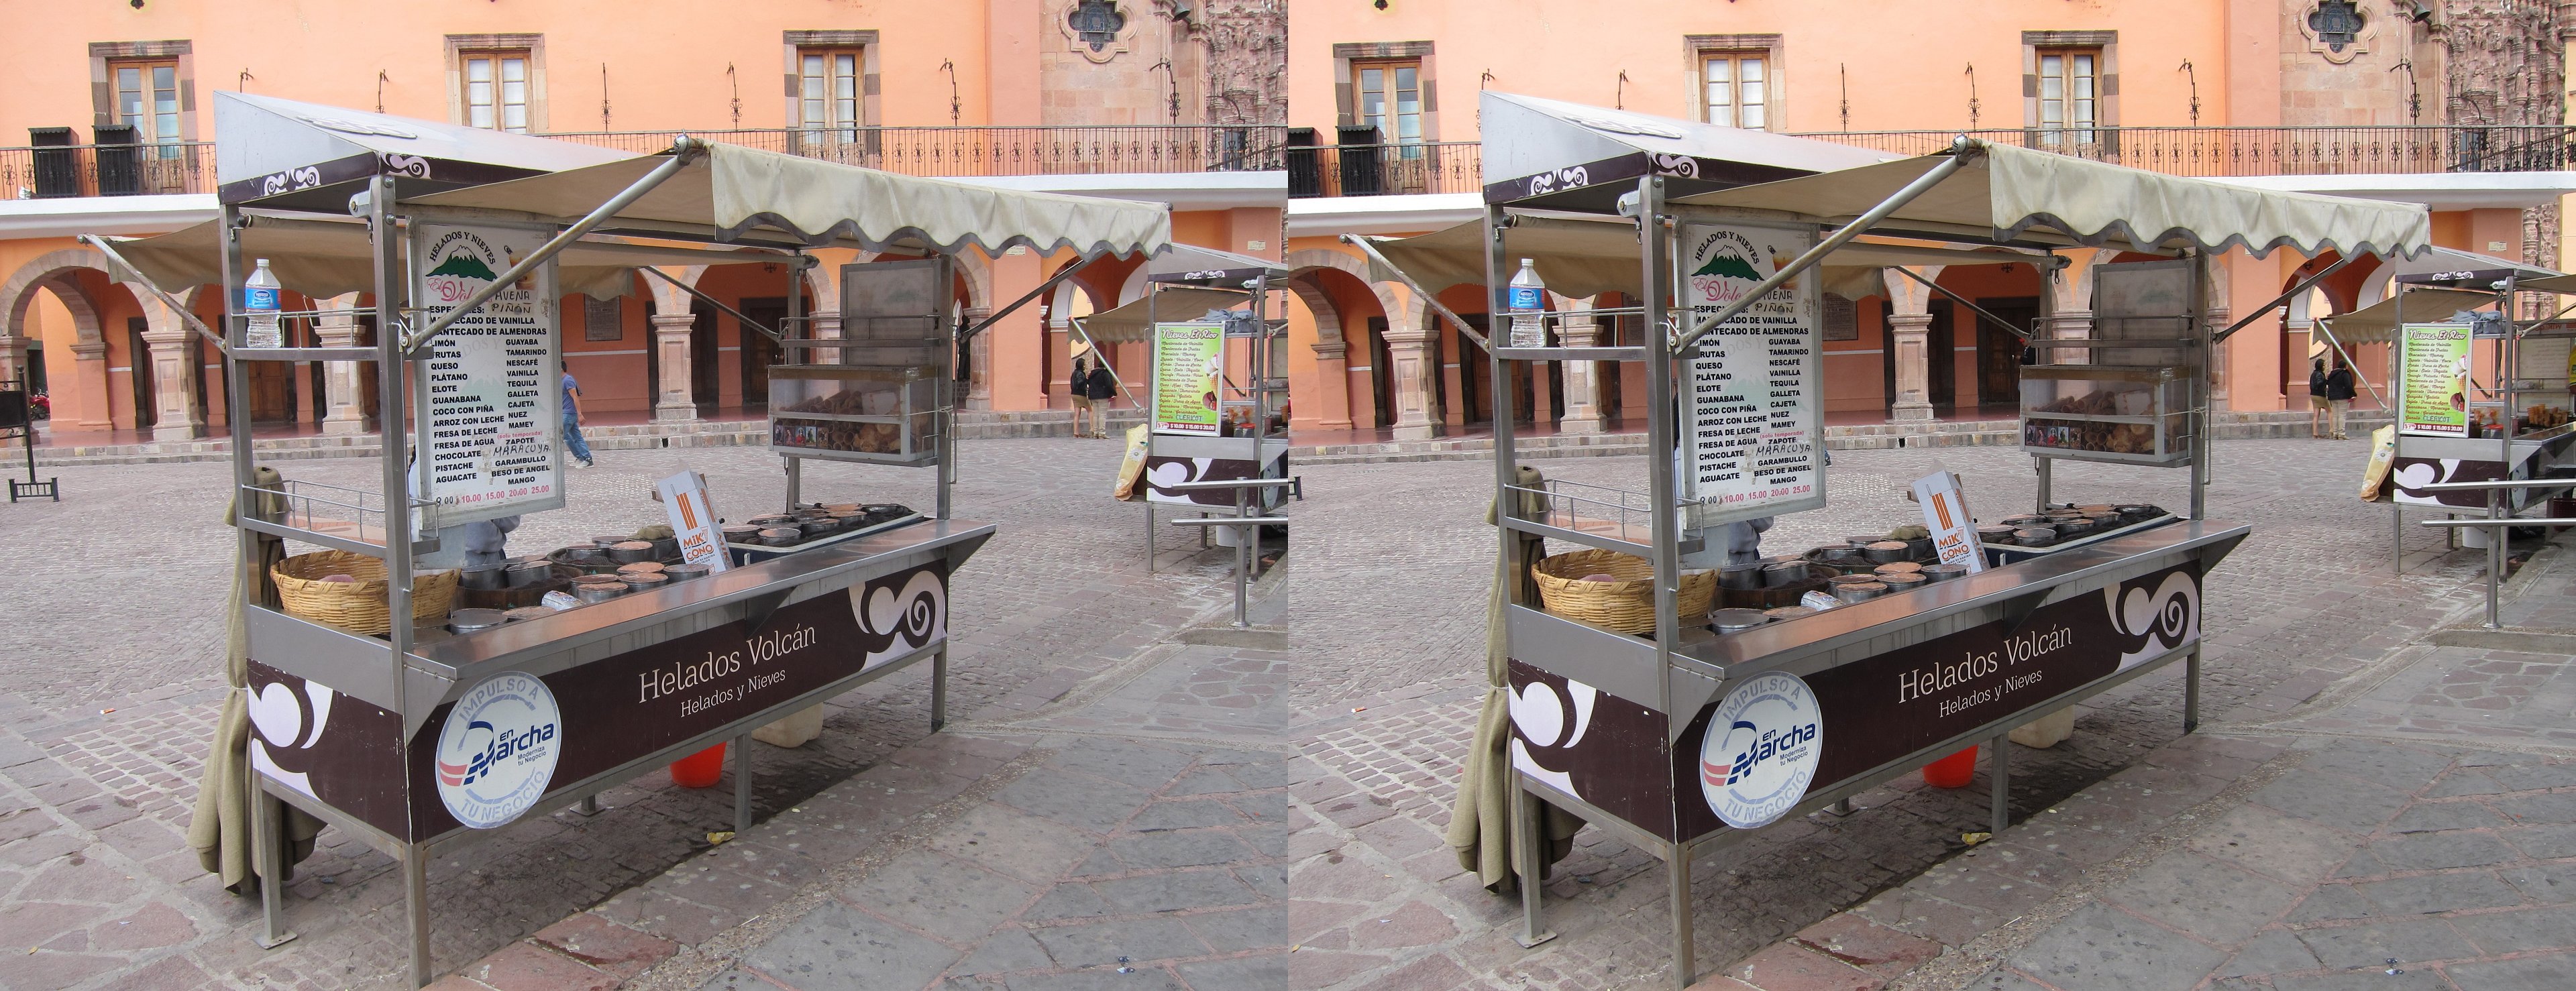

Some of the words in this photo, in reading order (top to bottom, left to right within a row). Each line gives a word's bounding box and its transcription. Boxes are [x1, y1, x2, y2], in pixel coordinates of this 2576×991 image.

[429, 231, 462, 261] HELADOS
[472, 235, 495, 264] NIEVES
[1695, 231, 1727, 261] HELADOS
[1736, 235, 1759, 264] NIEVES
[495, 291, 529, 300] AVENA
[1162, 330, 1189, 339] Nieves
[1190, 330, 1199, 339] El
[1200, 330, 1218, 339] Rico
[2409, 330, 2436, 340] Nieves
[2437, 331, 2447, 340] El
[2449, 331, 2466, 340] Rico
[432, 396, 481, 404] GUANABANA
[476, 405, 494, 413] PIÑA
[1739, 404, 1756, 412] PIÑA
[474, 427, 497, 435] LECHE
[435, 451, 481, 461] CHOCOLATE
[495, 456, 545, 466] GARAMBULLO
[1699, 450, 1744, 460] CHOCOLATE
[1758, 456, 1807, 466] GARAMBULLO
[435, 463, 473, 472] PISTACHE
[1700, 462, 1736, 471] PISTACHE
[436, 473, 477, 483] AGUACATE
[508, 477, 535, 485] MANGO
[1700, 473, 1739, 483] AGUACATE
[1770, 477, 1796, 485] MANGO
[462, 494, 481, 503] 10.00
[486, 491, 504, 500] 15.00
[509, 488, 527, 496] 20.00
[531, 485, 549, 493] 25.00
[1725, 493, 1743, 503] 10.00
[1749, 491, 1767, 500] 15.00
[1771, 488, 1788, 496] 20.00
[1793, 485, 1810, 493] 25.00
[686, 544, 714, 562] CONO
[1942, 544, 1970, 562] CONO
[639, 651, 740, 703] Helados
[746, 623, 816, 665] Volcán
[1898, 651, 1997, 703] Helados
[2004, 624, 2072, 665] Volcán
[459, 678, 527, 721] IMPULSO
[529, 686, 538, 700] A
[681, 689, 733, 718] Helados
[737, 685, 744, 701] y
[748, 669, 786, 693] Nieves
[1723, 679, 1788, 721] IMPULSO
[1791, 687, 1801, 700] A
[1939, 689, 1990, 718] Helados
[1994, 685, 2002, 701] y
[2005, 671, 2042, 693] Nieves
[464, 723, 554, 785] Marcha
[517, 746, 545, 760] Moderniza
[525, 751, 546, 764] Negocio
[1727, 723, 1815, 785] Marcha
[1780, 746, 1807, 760] Moderniza
[1787, 751, 1808, 763] Negocio
[462, 799, 478, 817] TU
[482, 770, 545, 821] NEGOCIO
[1725, 799, 1741, 817] TU
[1744, 770, 1806, 821] NEGOCIO
